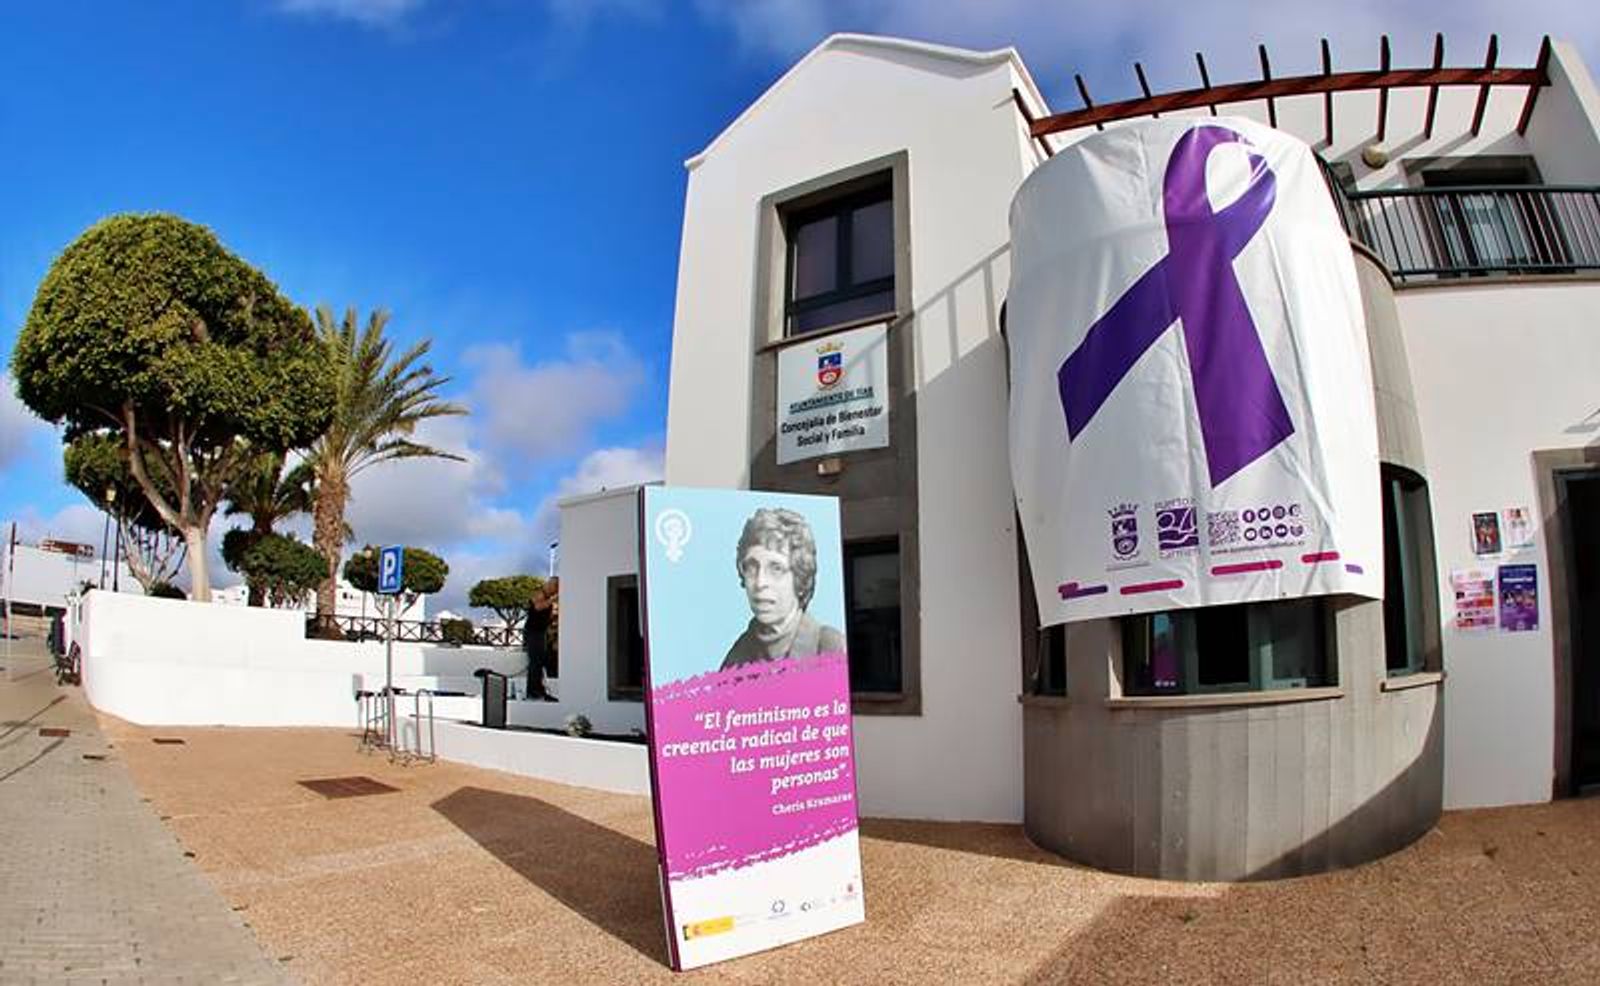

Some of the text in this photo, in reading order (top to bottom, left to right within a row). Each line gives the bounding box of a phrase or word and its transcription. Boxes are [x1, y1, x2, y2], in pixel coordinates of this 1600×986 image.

[826, 413, 837, 425] de
[838, 406, 883, 423] Bienestar
[797, 433, 823, 447] Social
[825, 433, 830, 444] y
[382, 551, 397, 588] P
[724, 705, 810, 733] feminismo
[814, 703, 830, 717] es
[833, 700, 848, 715] la
[662, 723, 849, 758] creencia radical de que
[731, 745, 849, 774] las mujeres son
